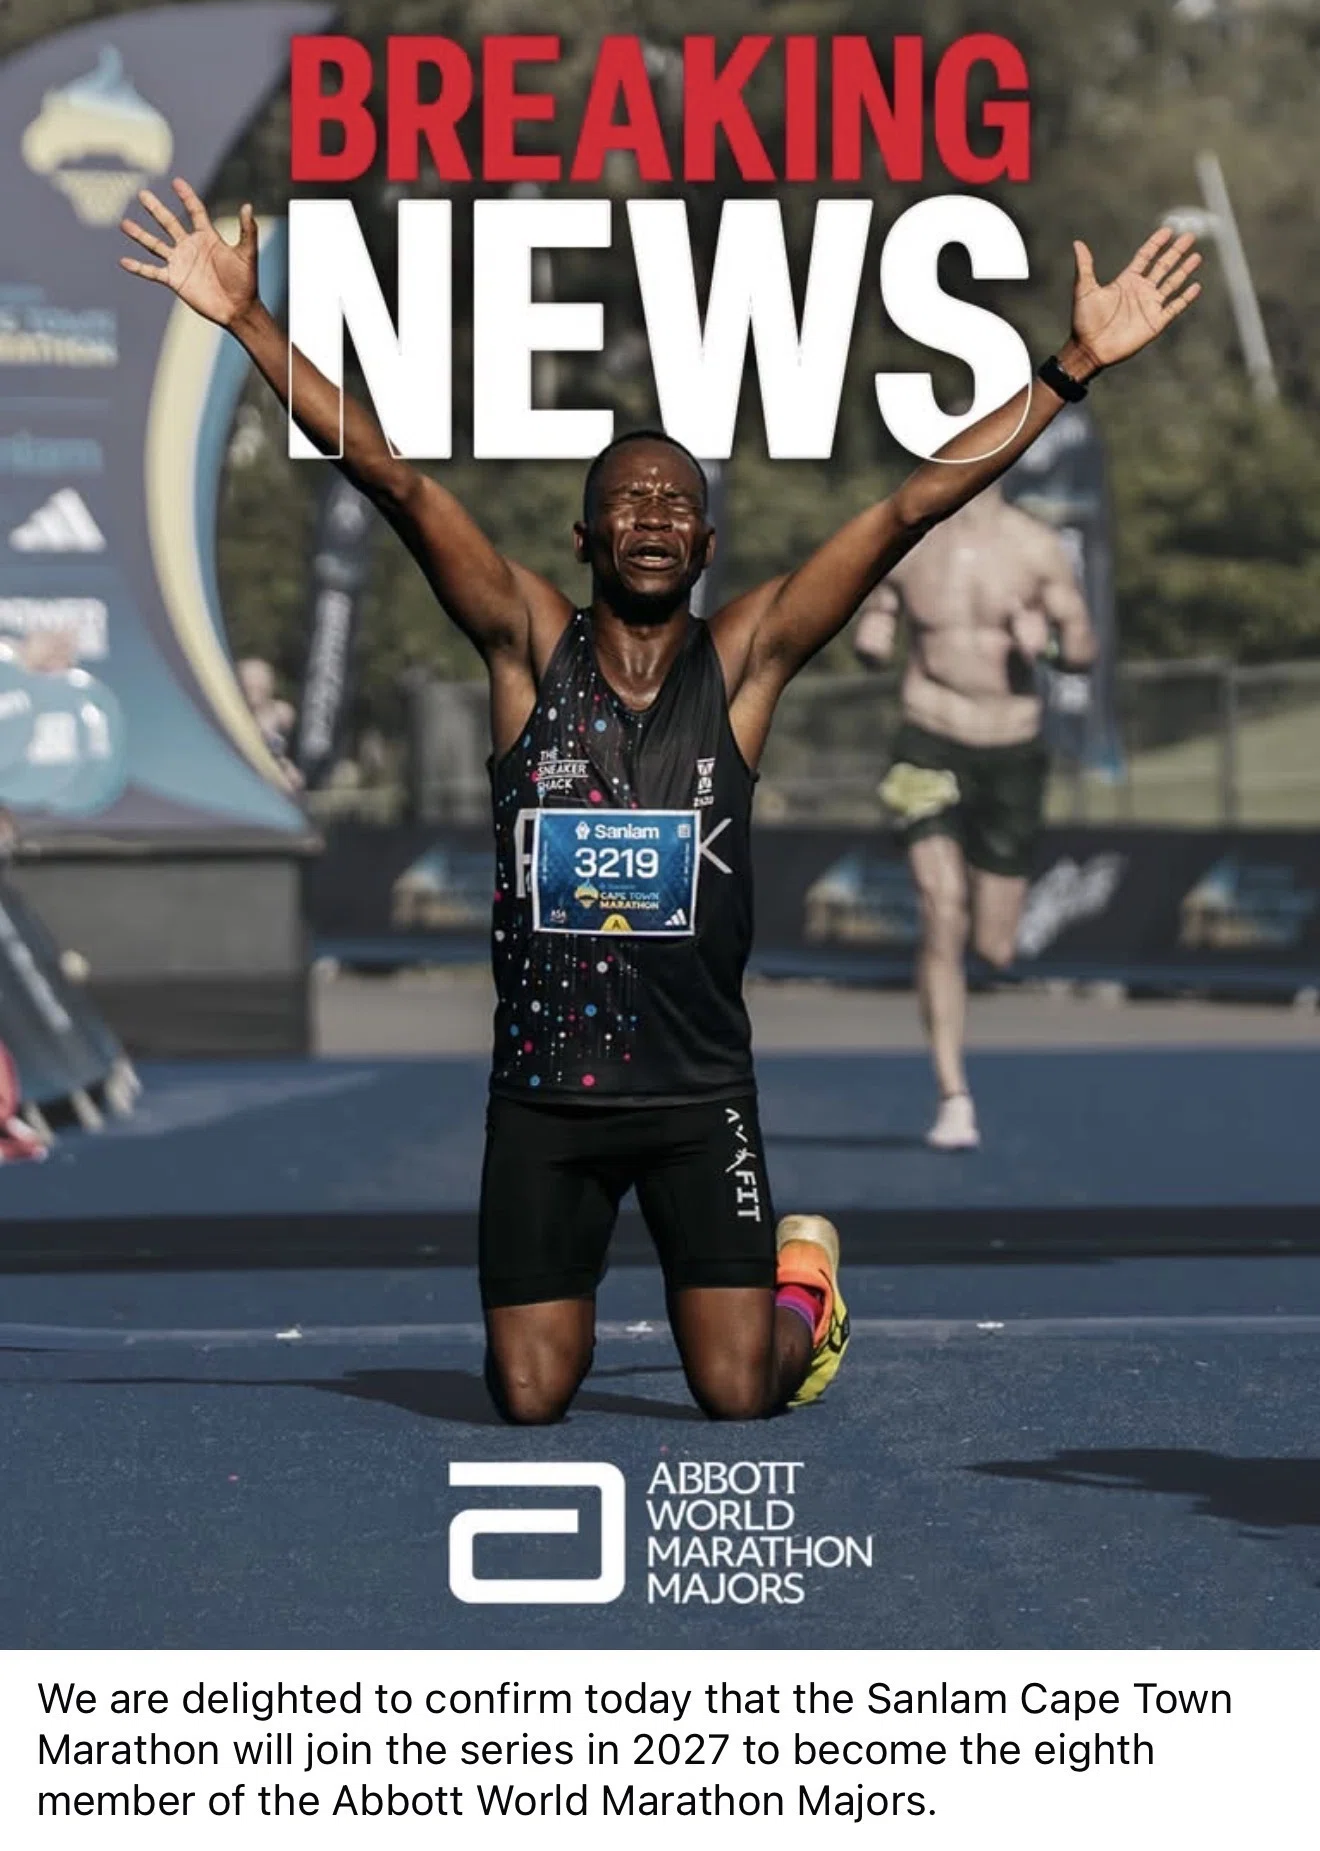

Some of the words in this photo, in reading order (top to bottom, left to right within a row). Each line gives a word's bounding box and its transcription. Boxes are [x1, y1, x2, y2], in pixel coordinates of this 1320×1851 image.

[537, 763, 588, 776] SNEAKER
[594, 823, 660, 839] Sanlam
[574, 847, 660, 879] 3219
[601, 891, 627, 900] CAPE
[629, 891, 660, 900] TOWN
[600, 901, 660, 910] MARATHON
